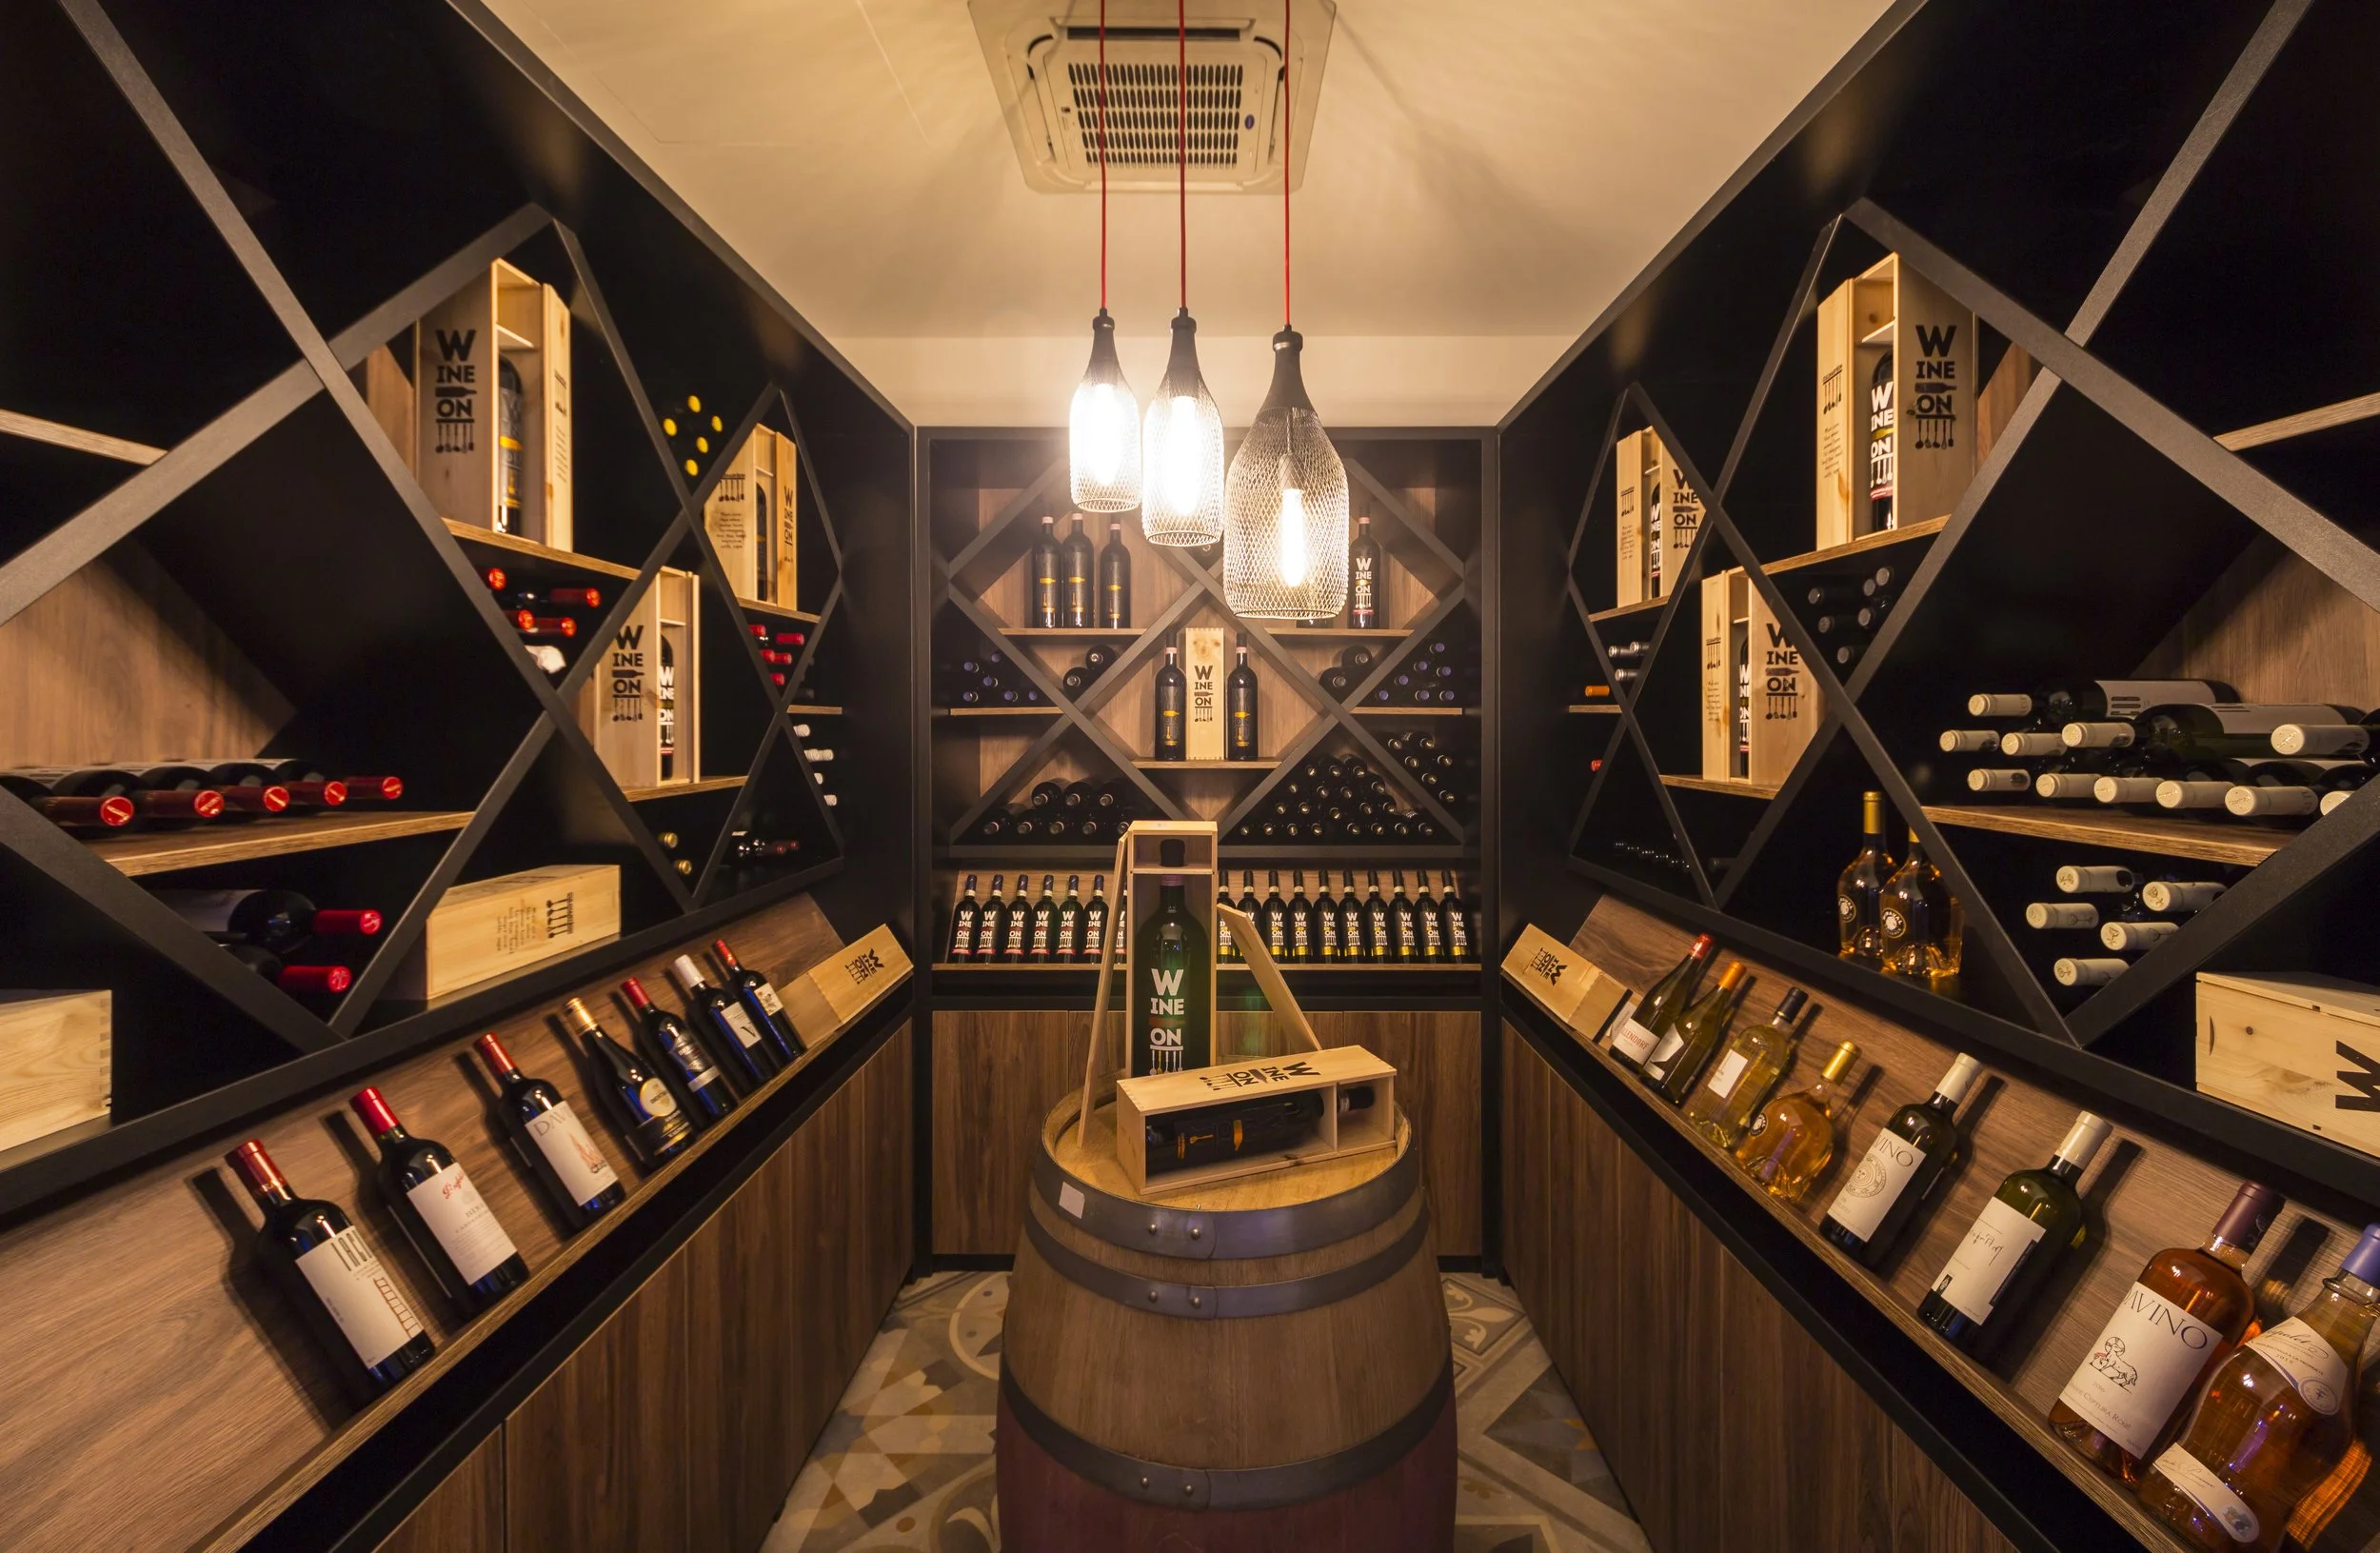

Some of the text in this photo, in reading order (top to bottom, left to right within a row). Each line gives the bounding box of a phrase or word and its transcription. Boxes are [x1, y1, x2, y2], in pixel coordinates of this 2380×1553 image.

[436, 329, 476, 361] W
[1914, 325, 1957, 357] W
[436, 365, 475, 384] INE
[1915, 361, 1954, 379] INE
[1872, 382, 1894, 410] W
[436, 399, 471, 417] ON
[1916, 395, 1951, 413] ON
[1872, 408, 1894, 431] INE
[1872, 438, 1891, 458] ON
[1674, 514, 1696, 526] ON
[1356, 558, 1372, 570] W
[616, 626, 644, 649] W
[612, 653, 644, 667] INE
[1766, 651, 1798, 665] INE
[1194, 666, 1213, 680] W
[613, 680, 641, 693] ON
[1195, 682, 1213, 690] INE
[1767, 678, 1795, 692] ON
[1195, 697, 1212, 706] ON
[961, 911, 974, 921] W
[983, 911, 997, 921] W
[1012, 911, 1025, 921] W
[1037, 911, 1049, 921] W
[1062, 911, 1075, 921] W
[1089, 911, 1101, 921] W
[1271, 912, 1282, 921] W
[1295, 912, 1306, 921] W
[1323, 912, 1335, 921] W
[1346, 912, 1358, 921] W
[1373, 912, 1384, 921] W
[1400, 912, 1412, 921] W
[1425, 912, 1437, 921] W
[1451, 912, 1462, 921] W
[862, 953, 878, 975] INE
[868, 948, 884, 968] W
[1537, 954, 1551, 972] ON
[855, 959, 868, 978] ON
[1543, 958, 1559, 980] INE
[1551, 965, 1568, 986] W
[1151, 968, 1184, 996] W
[1150, 998, 1184, 1015] INE
[1150, 1027, 1181, 1045] ON
[1260, 1066, 1291, 1083] INE
[1282, 1062, 1321, 1077] W
[1234, 1071, 1259, 1086] ON
[2123, 1289, 2208, 1350] AVINO
